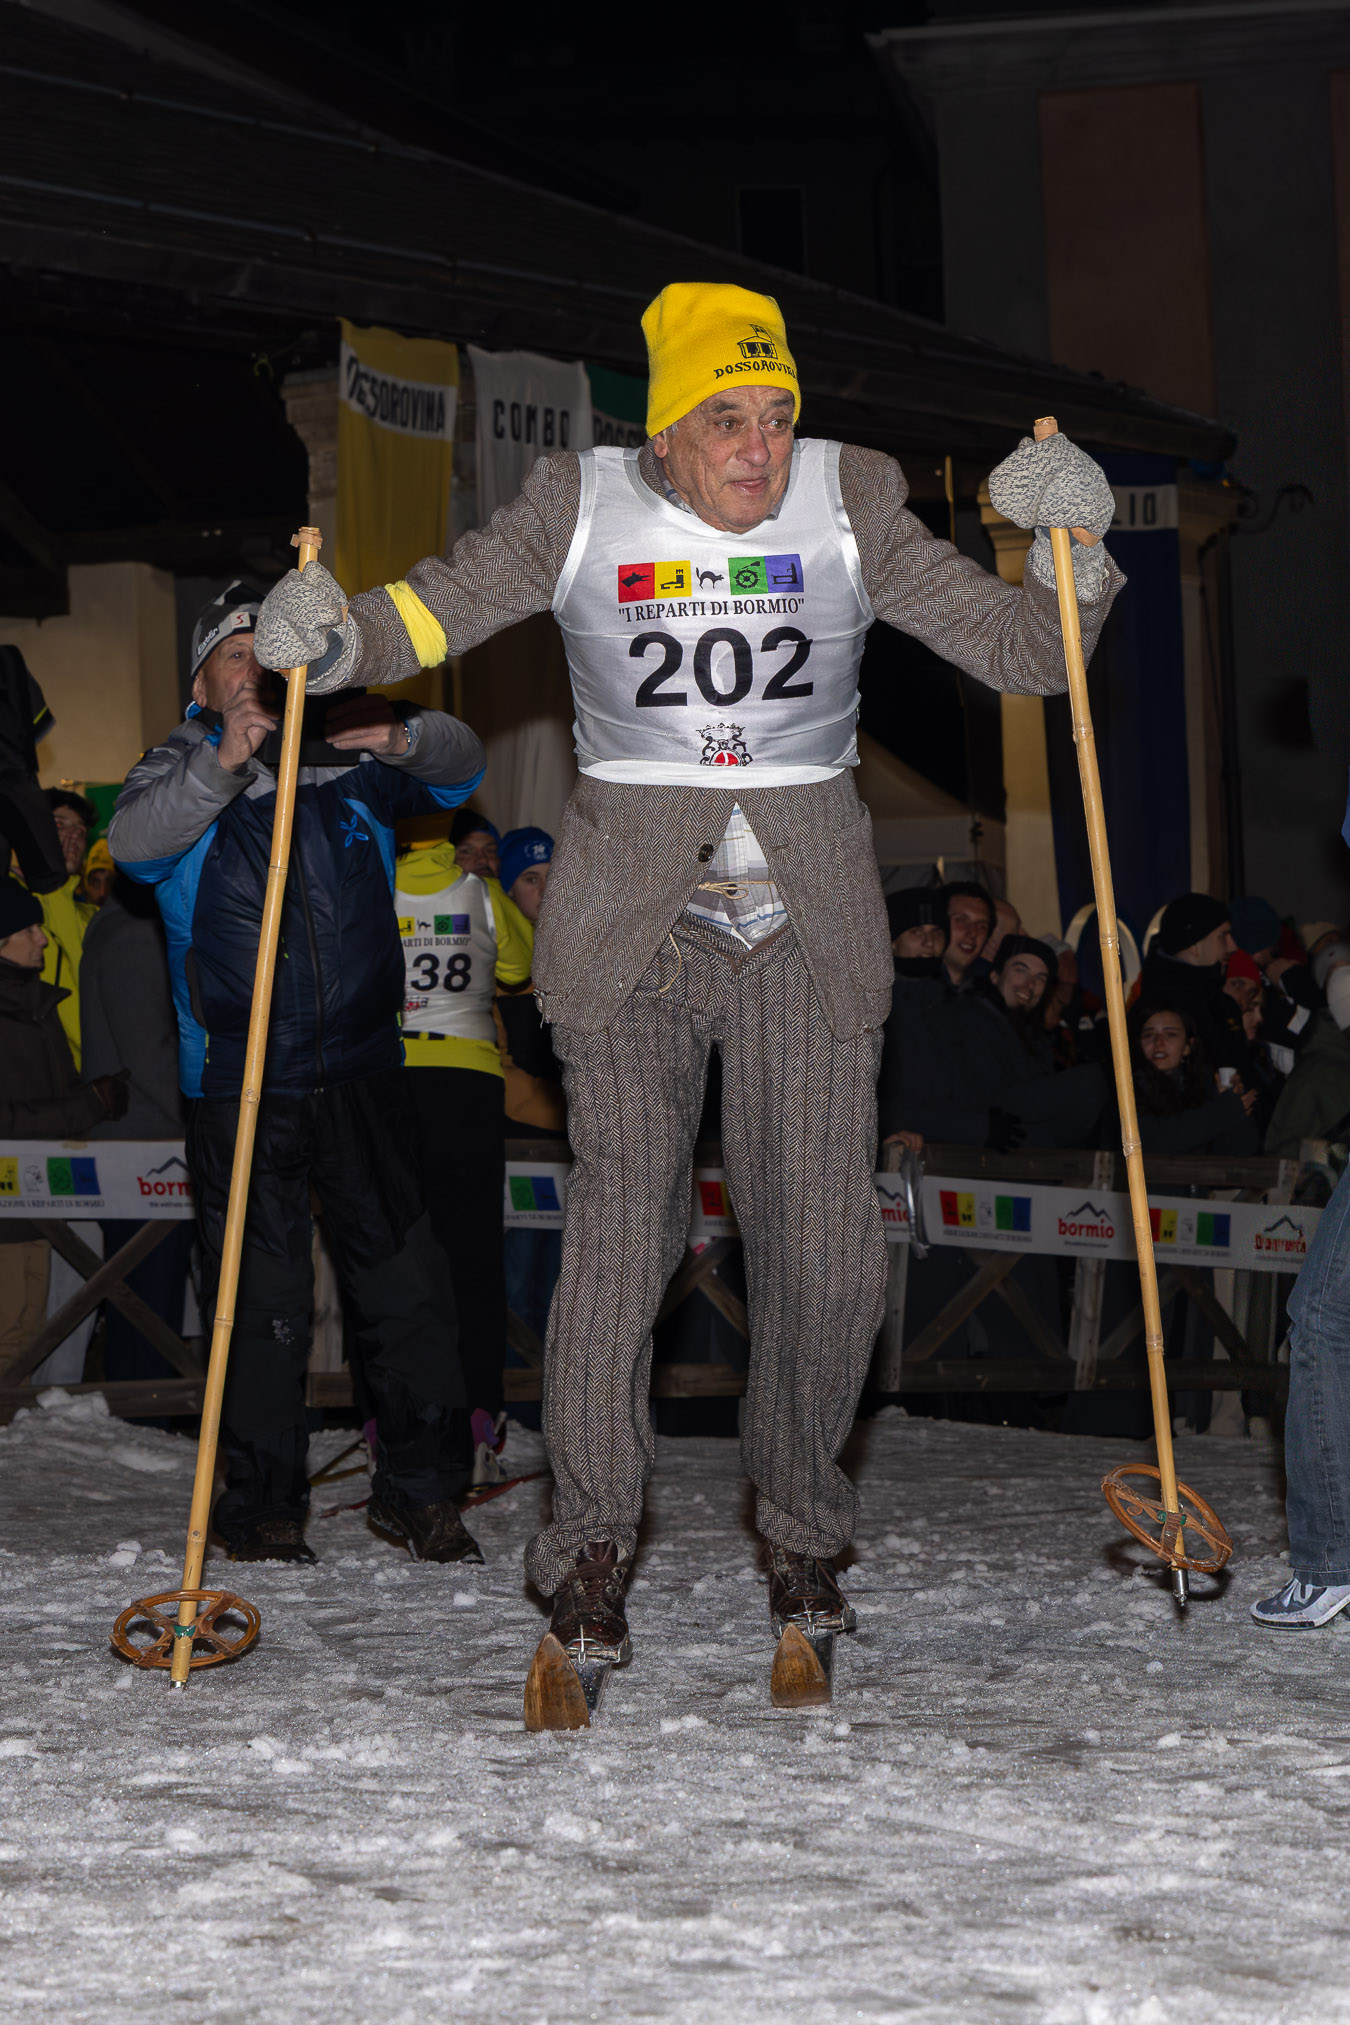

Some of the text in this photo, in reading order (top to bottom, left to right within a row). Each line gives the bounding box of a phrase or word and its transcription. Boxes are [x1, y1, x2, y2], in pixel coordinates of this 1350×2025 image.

[493, 399, 570, 449] COMBO
[635, 601, 705, 621] REPARTI
[711, 601, 729, 615] DI
[733, 598, 805, 615] BORMIO"
[629, 626, 813, 707] 202
[410, 952, 472, 992] 38
[1058, 1218, 1115, 1239] bormio
